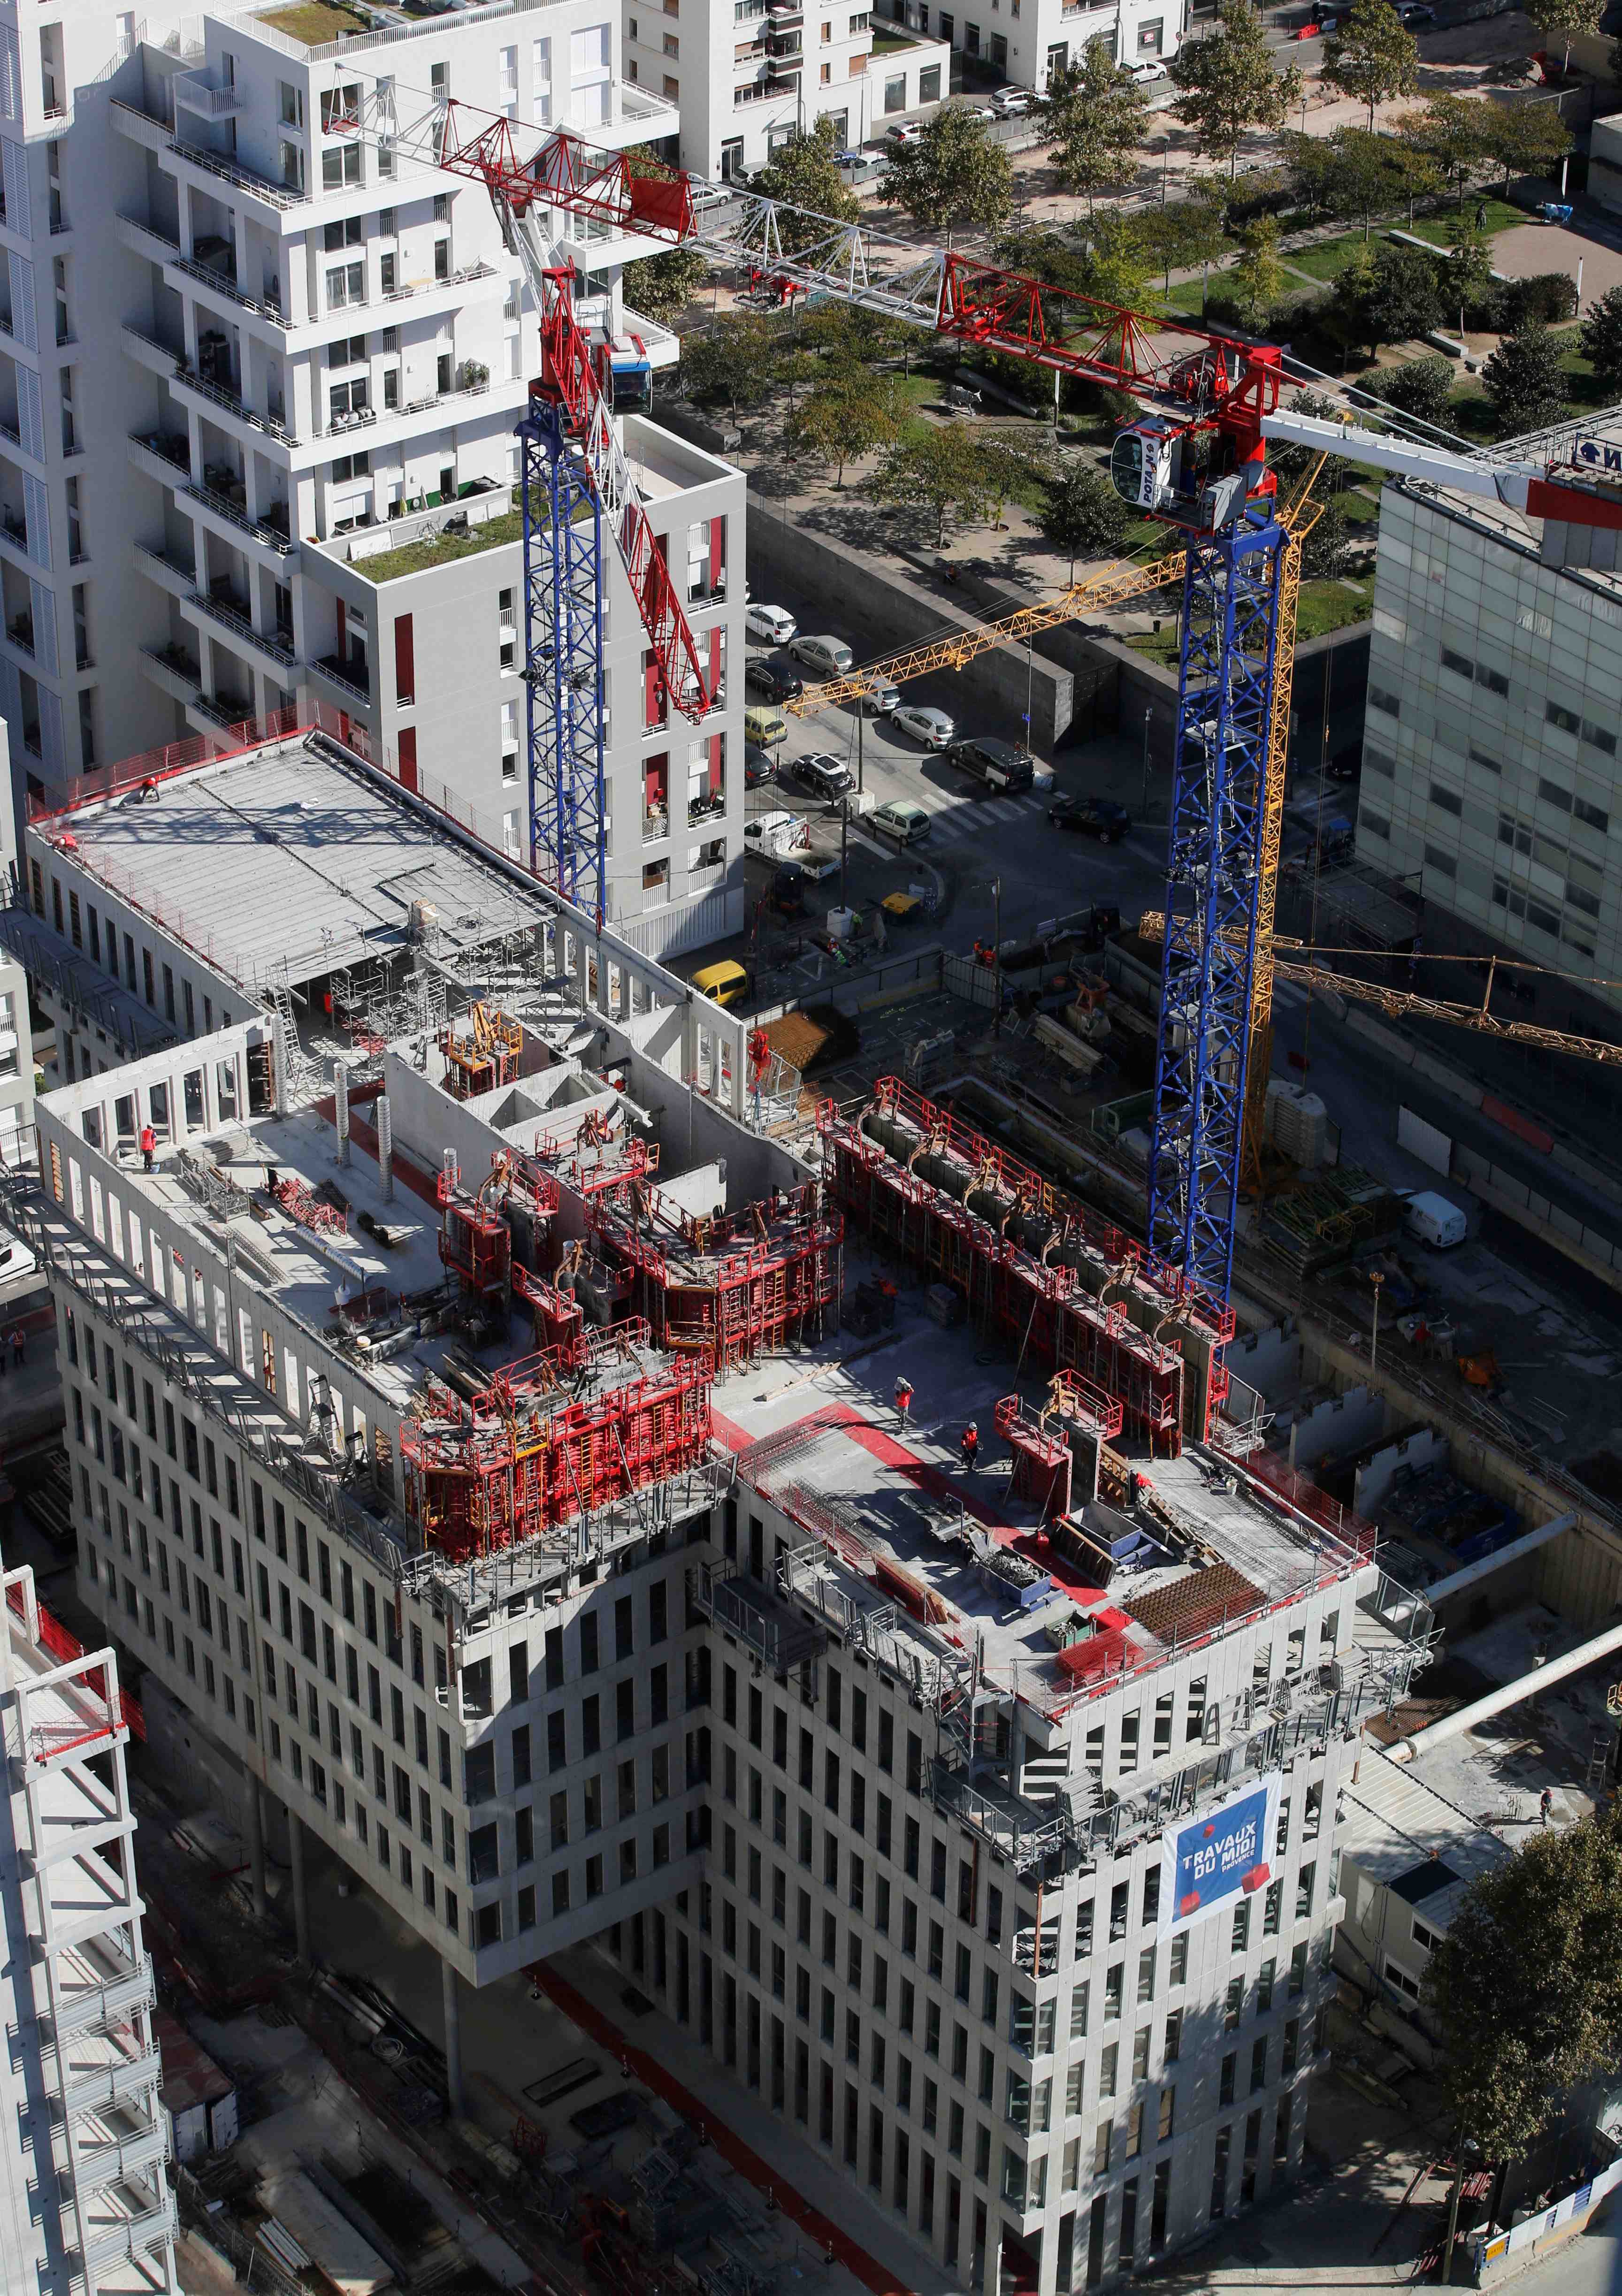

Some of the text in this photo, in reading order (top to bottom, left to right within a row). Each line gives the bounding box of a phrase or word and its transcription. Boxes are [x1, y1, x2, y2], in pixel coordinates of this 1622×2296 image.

[1143, 454, 1154, 503] POTAN
[1183, 1821, 1256, 1869] TRAVAUX
[1194, 1835, 1255, 1880] DU MIDI
[1222, 1849, 1255, 1873] PROVENCE
